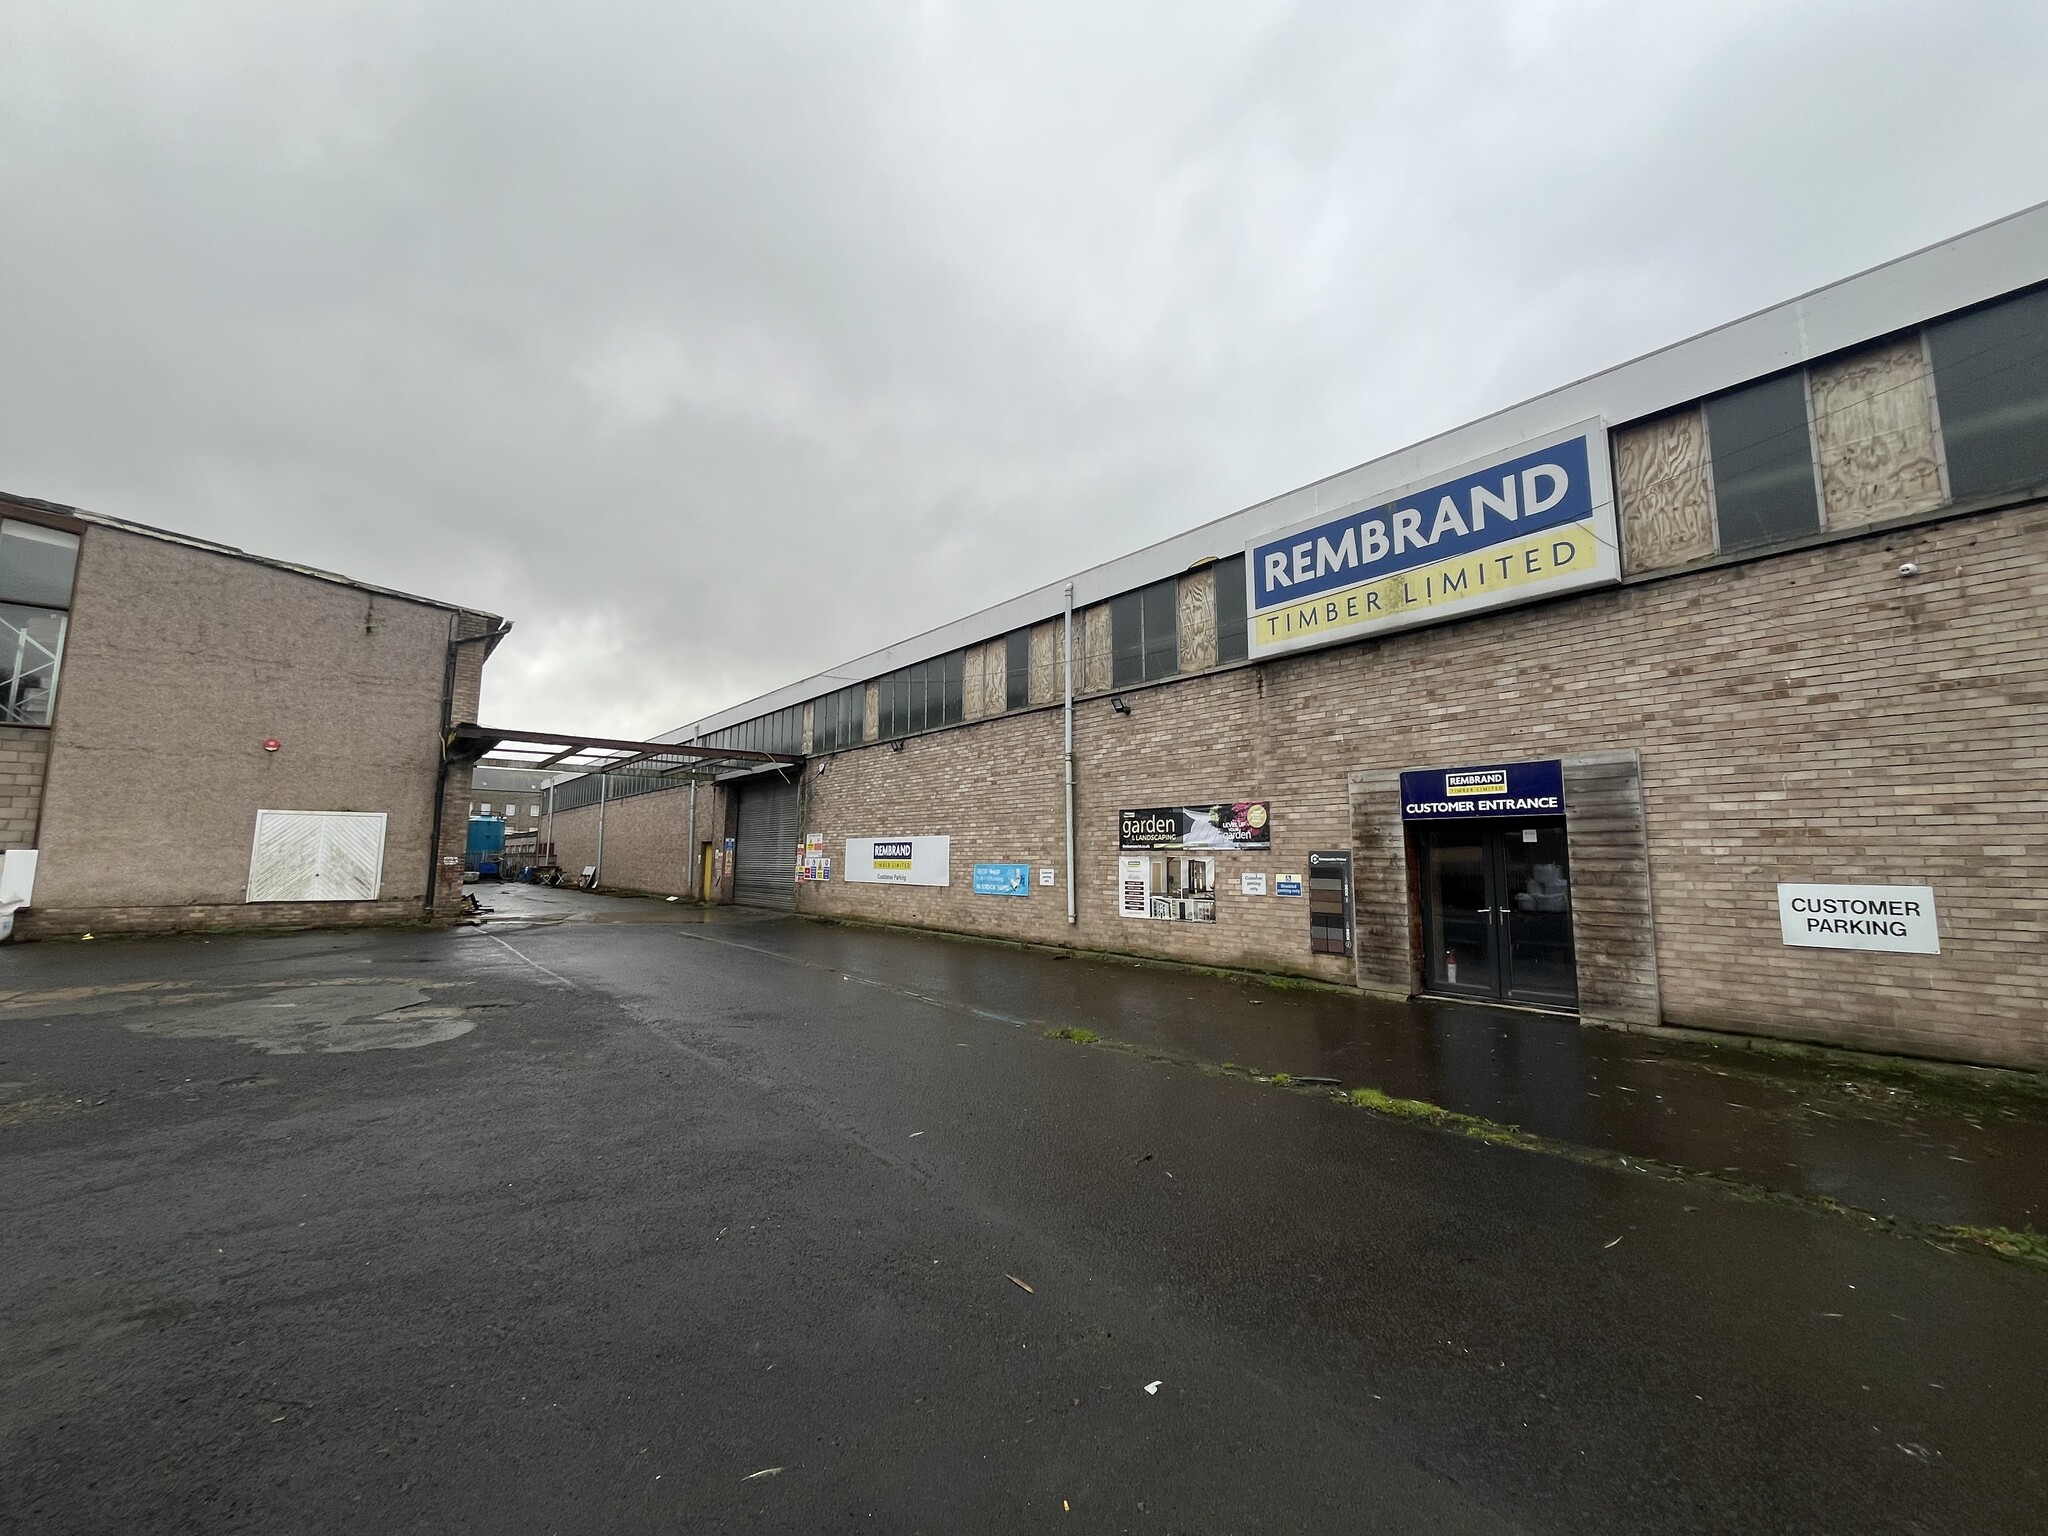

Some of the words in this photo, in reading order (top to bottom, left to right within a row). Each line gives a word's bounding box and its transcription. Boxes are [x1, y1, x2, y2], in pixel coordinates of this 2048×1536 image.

[1264, 463, 1570, 592] REMBRAND
[1266, 591, 1382, 636] TIMBER
[1404, 541, 1577, 604] LIMITED
[1449, 774, 1503, 786] REMBRAND
[1406, 801, 1475, 814] CUSTOMER
[1478, 797, 1558, 811] ENTRANCE
[1122, 814, 1175, 838] garden
[1222, 820, 1239, 828] LEVEL
[874, 844, 911, 857] REMBRAND
[1791, 898, 1921, 917] CUSTOMER
[1807, 918, 1908, 937] PARKING
